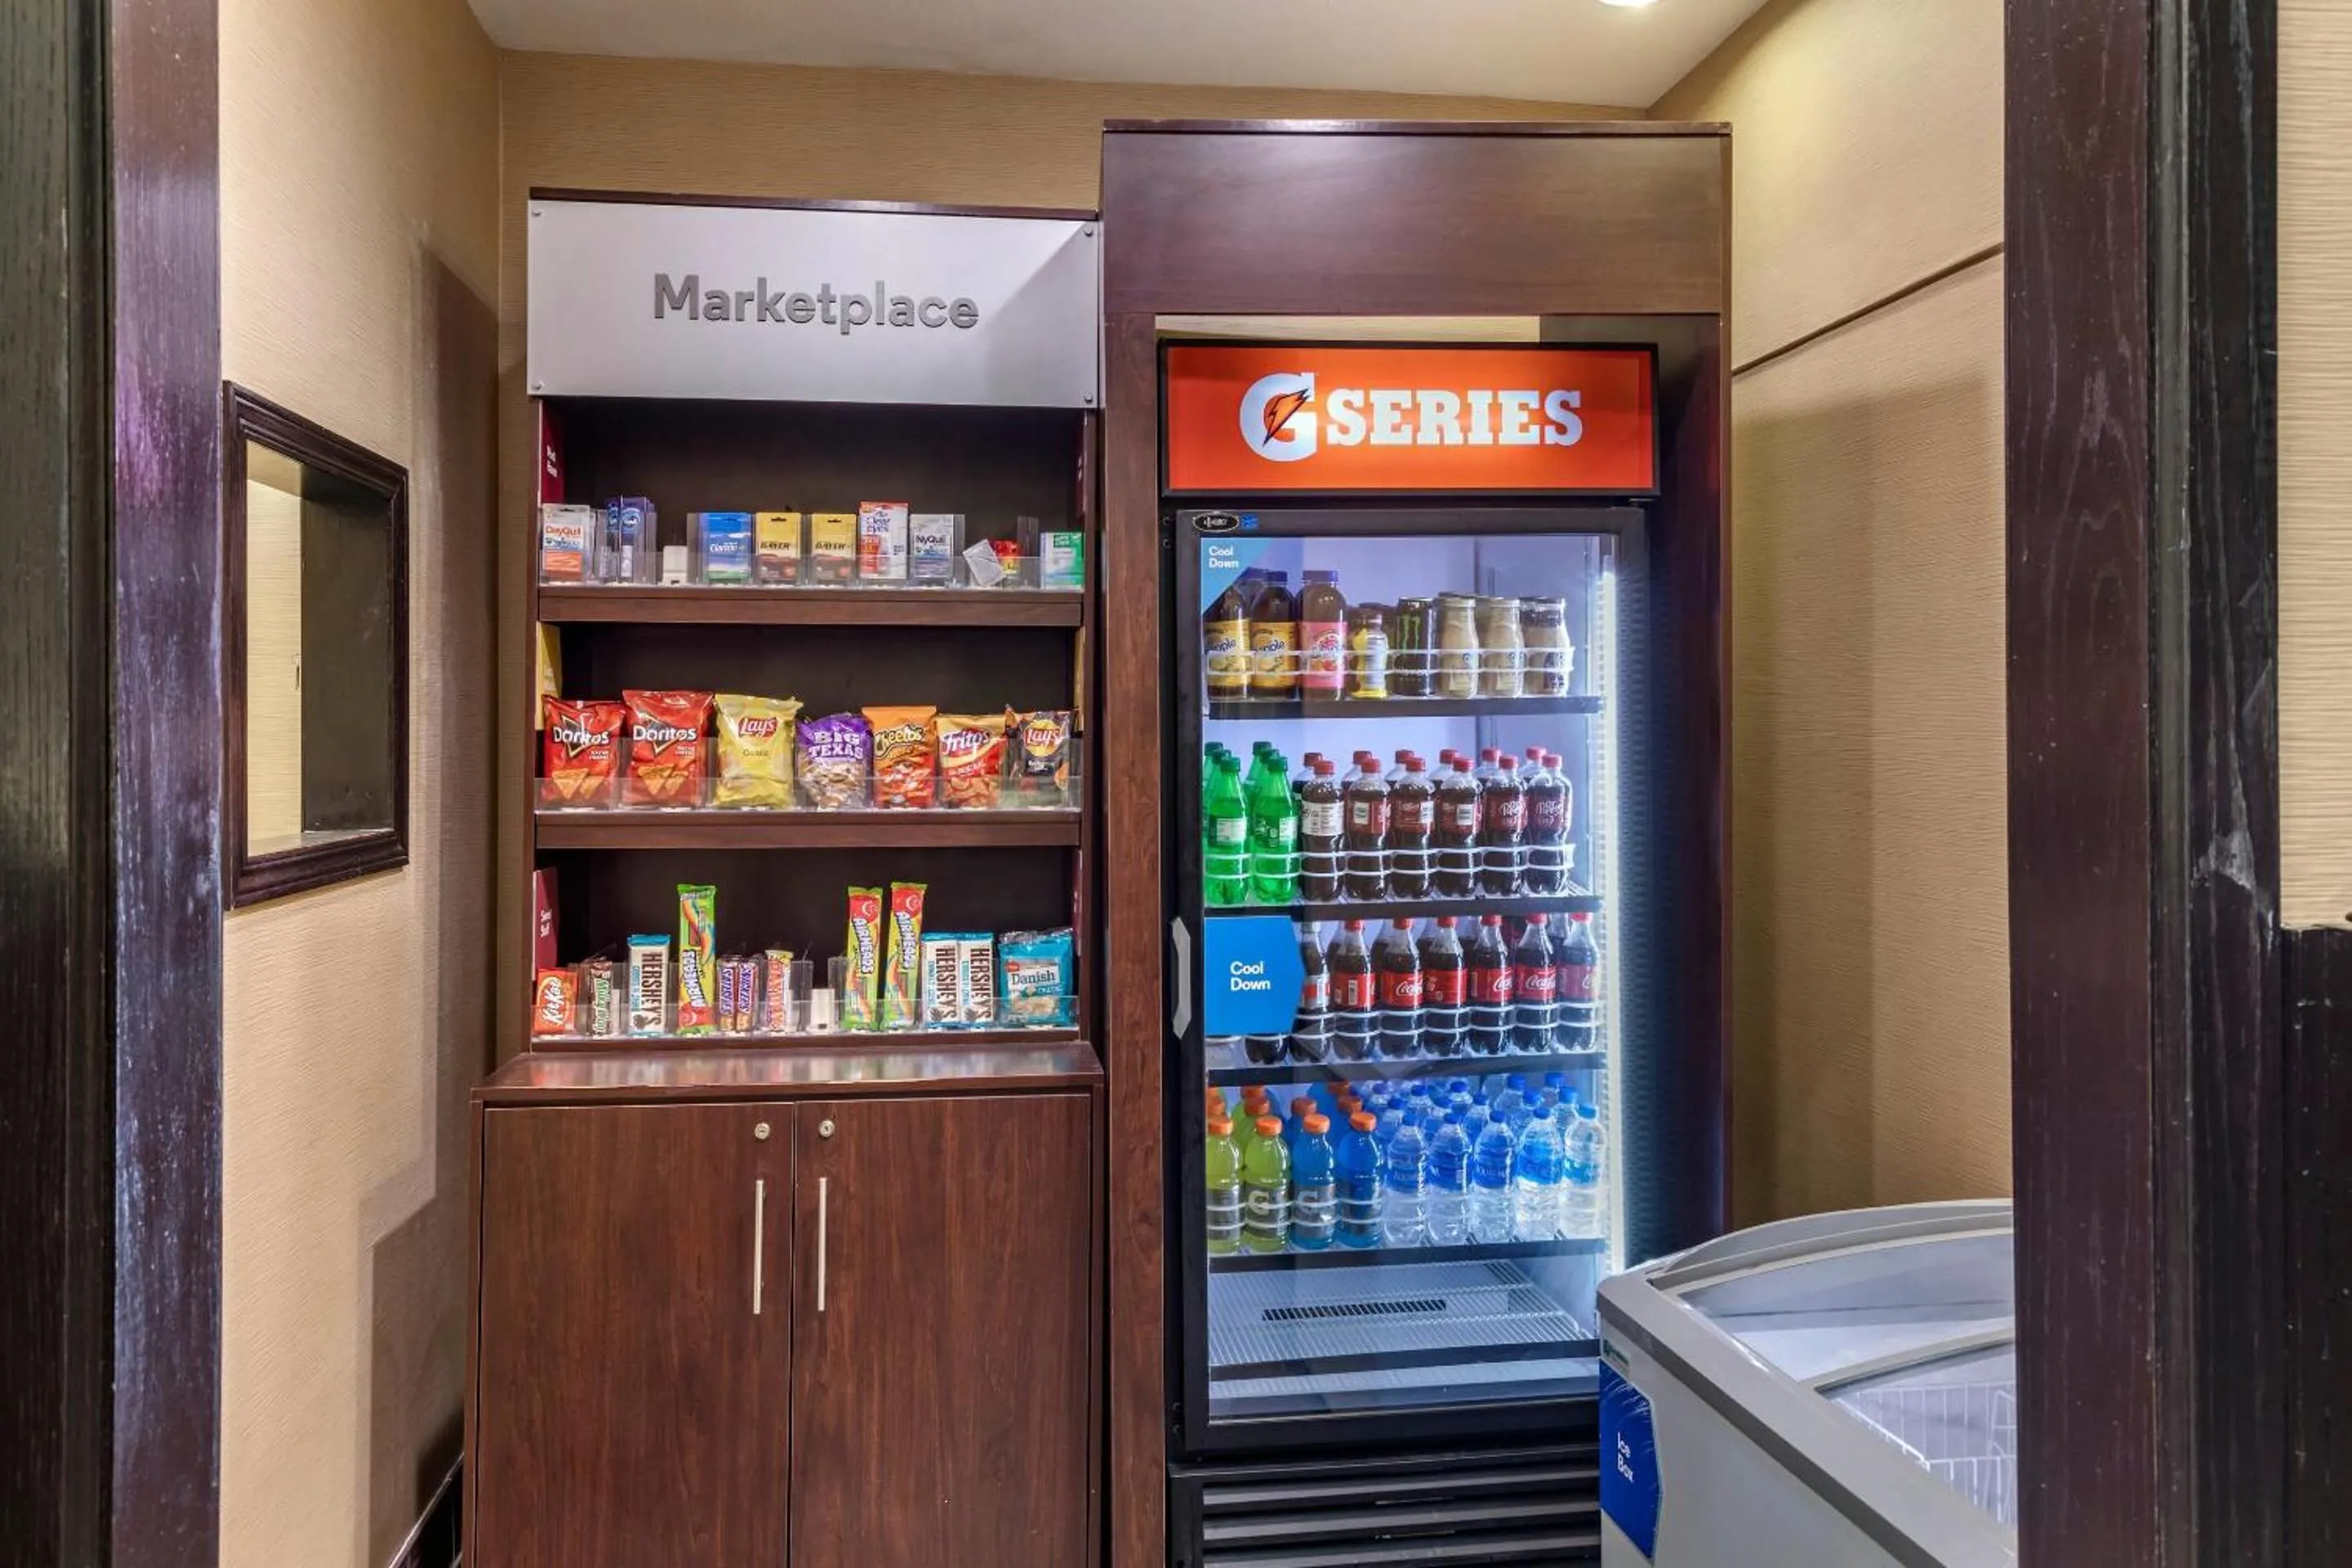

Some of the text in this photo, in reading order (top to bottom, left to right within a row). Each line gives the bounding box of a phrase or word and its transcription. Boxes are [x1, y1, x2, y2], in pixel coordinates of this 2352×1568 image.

[653, 273, 979, 335] Marketplace
[1239, 372, 1584, 462] G SERIES
[1209, 546, 1233, 556] Cool
[1209, 558, 1240, 568] Down
[552, 724, 610, 745] Doritos
[632, 724, 697, 741] Doritos
[808, 742, 863, 760] TEXAS
[940, 728, 990, 756] Fritos
[1230, 960, 1264, 976] Cool
[1012, 970, 1056, 985] Danish
[1230, 977, 1272, 991] Down
[1617, 1431, 1632, 1459] Ice
[1617, 1452, 1635, 1483] Box
